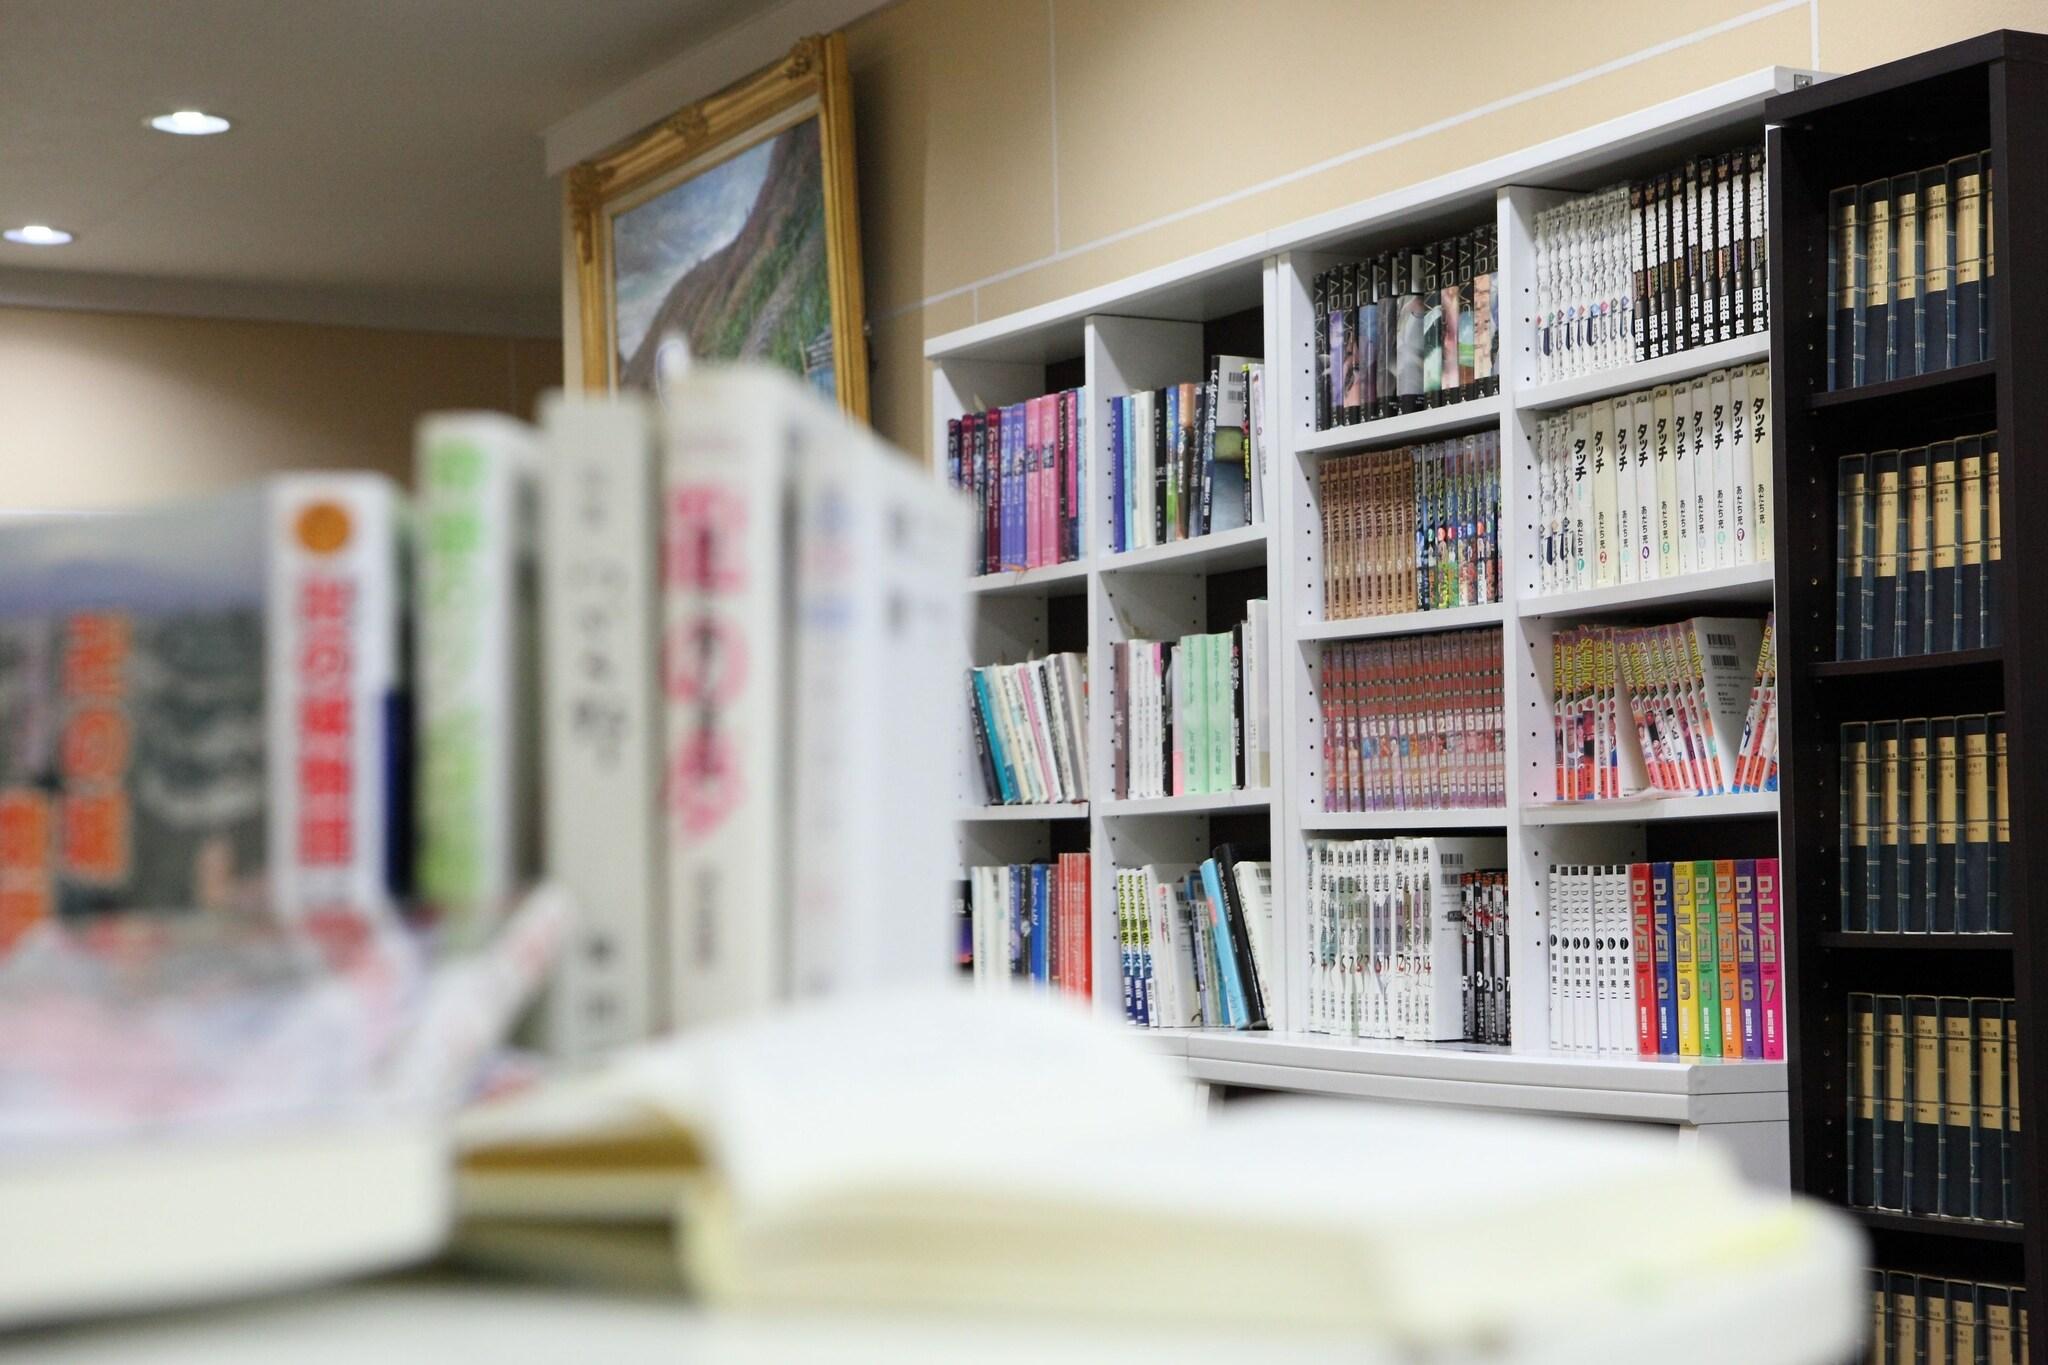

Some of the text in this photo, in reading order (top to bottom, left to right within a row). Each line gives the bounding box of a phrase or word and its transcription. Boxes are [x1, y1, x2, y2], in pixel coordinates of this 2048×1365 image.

[1657, 418, 1668, 462] タッチ
[1676, 416, 1686, 461] タッチ
[1693, 410, 1704, 455] タッチ
[1713, 404, 1724, 450] タッチ
[1733, 400, 1744, 446] タッチ
[1753, 398, 1766, 444] タッチ
[1574, 438, 1587, 482] タッチ
[1594, 431, 1605, 474] タッチ
[1617, 429, 1628, 472] タッチ
[1638, 424, 1648, 468] タッチ
[1336, 722, 1342, 738] 2
[1348, 722, 1356, 738] 3
[1370, 722, 1377, 736] 5
[1379, 720, 1386, 736] 6
[1388, 720, 1397, 737] 7
[1408, 720, 1414, 734] 9
[1560, 882, 1569, 932] ADAMAS
[1571, 882, 1580, 932] ADAMAS
[1580, 882, 1590, 932] ADAMAS
[1594, 882, 1604, 933] ADAMAS
[1605, 881, 1616, 932] ADAMAS
[1617, 881, 1628, 932] ADAMAS
[1476, 971, 1483, 988] 3
[1496, 978, 1504, 992] 6
[1639, 978, 1646, 999] 1
[1658, 978, 1668, 1000] 2
[1680, 978, 1690, 1000] 3
[1702, 978, 1712, 1000] 4
[1724, 979, 1734, 1000] 5
[1742, 979, 1754, 1000] 6
[1763, 980, 1776, 1002] 7
